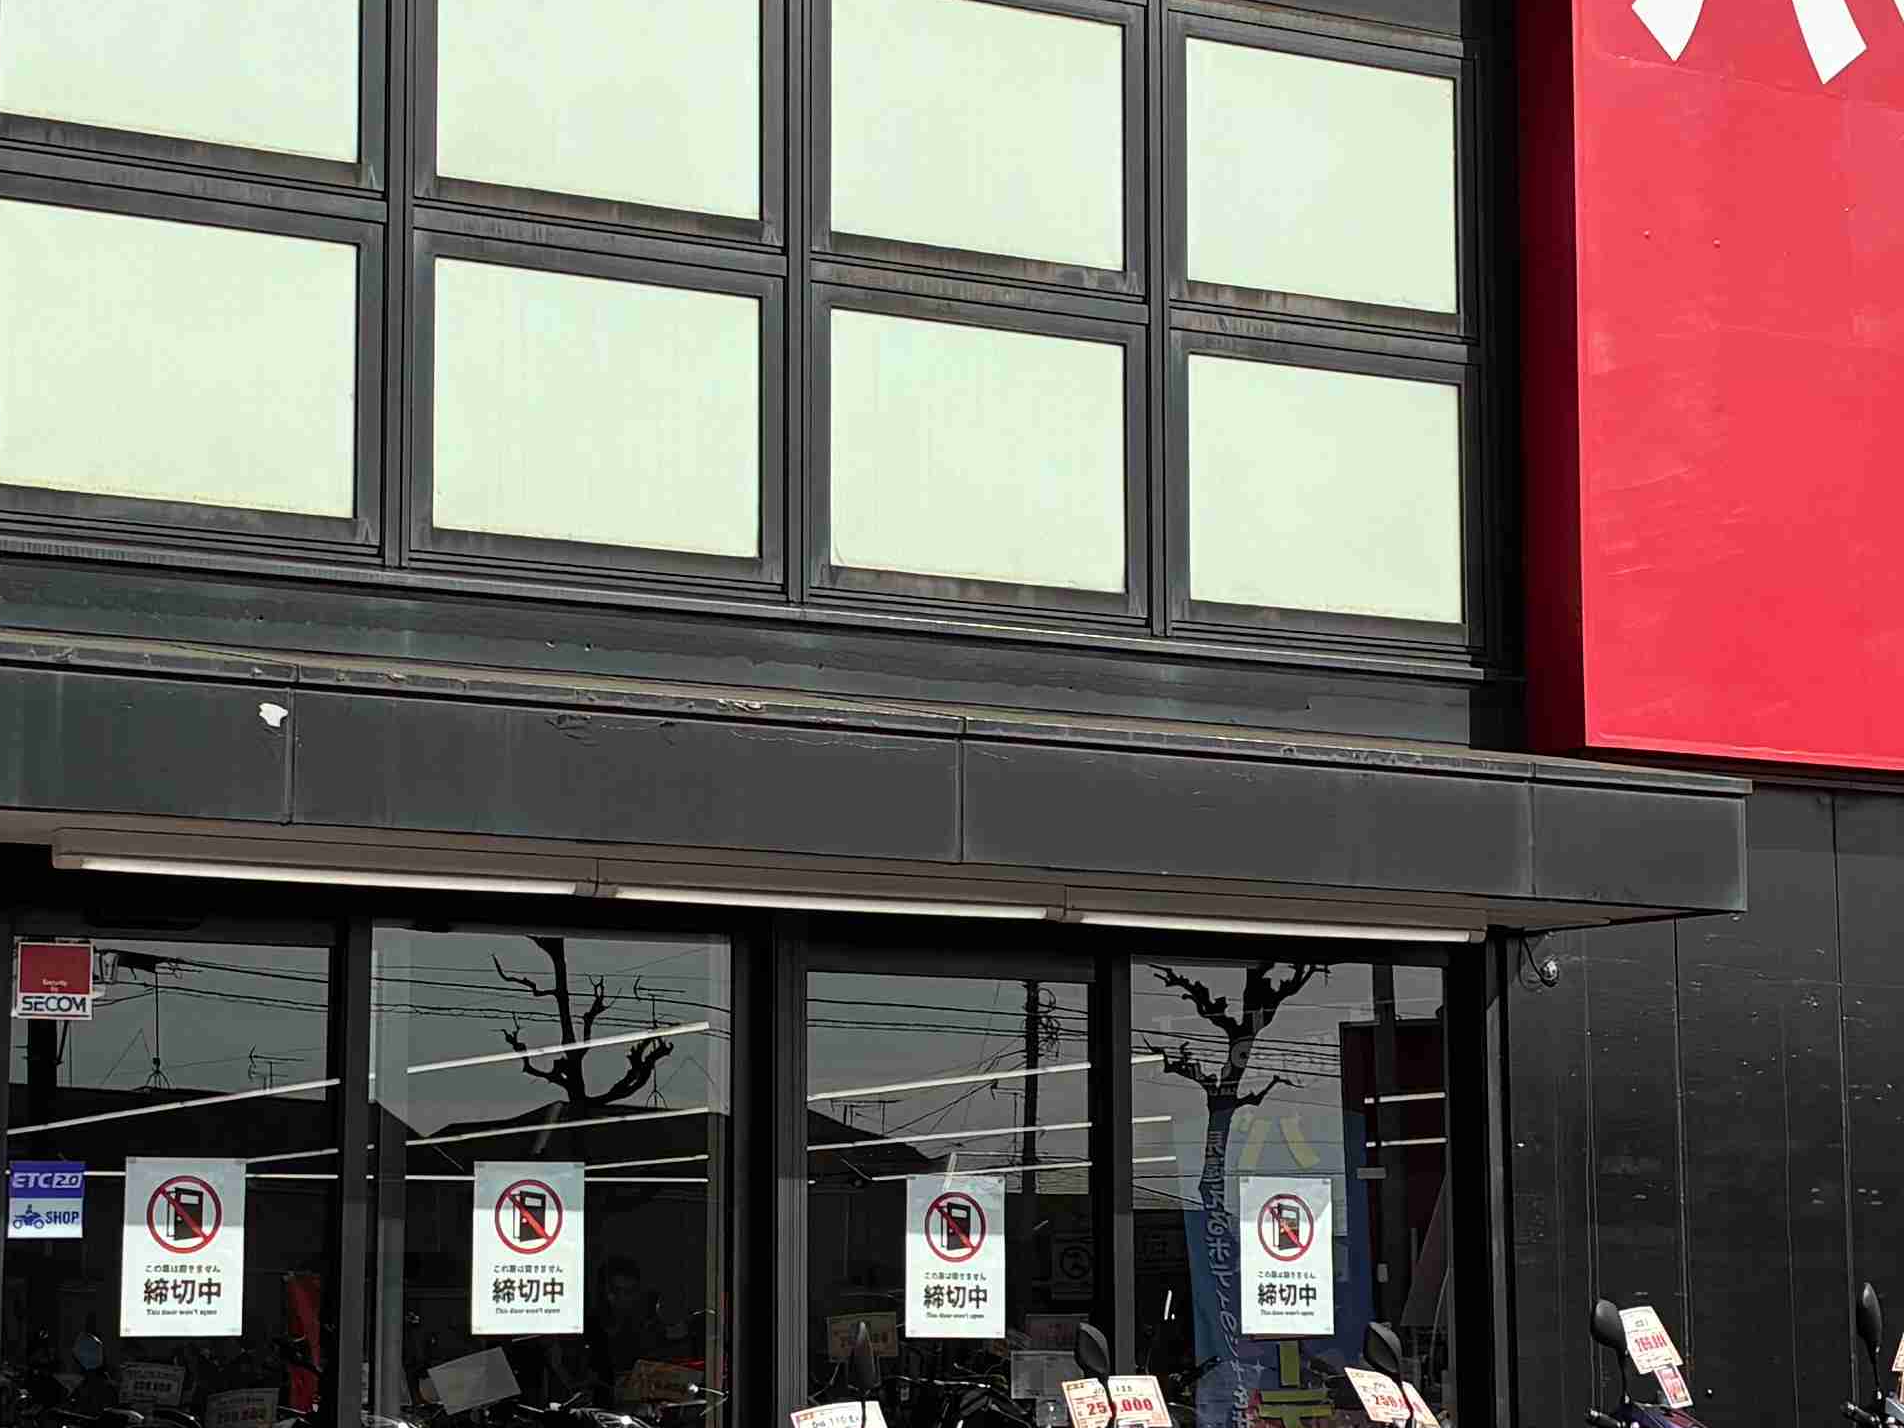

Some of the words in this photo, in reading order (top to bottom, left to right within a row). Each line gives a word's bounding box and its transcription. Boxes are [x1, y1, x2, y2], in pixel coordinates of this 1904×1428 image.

[22, 995, 87, 1013] SECOM
[45, 1210, 80, 1226] SHOP
[143, 1277, 222, 1305] 締切中
[492, 1277, 564, 1304] 締切中
[923, 1284, 988, 1309] 締切中
[1257, 1282, 1317, 1307] 締切中
